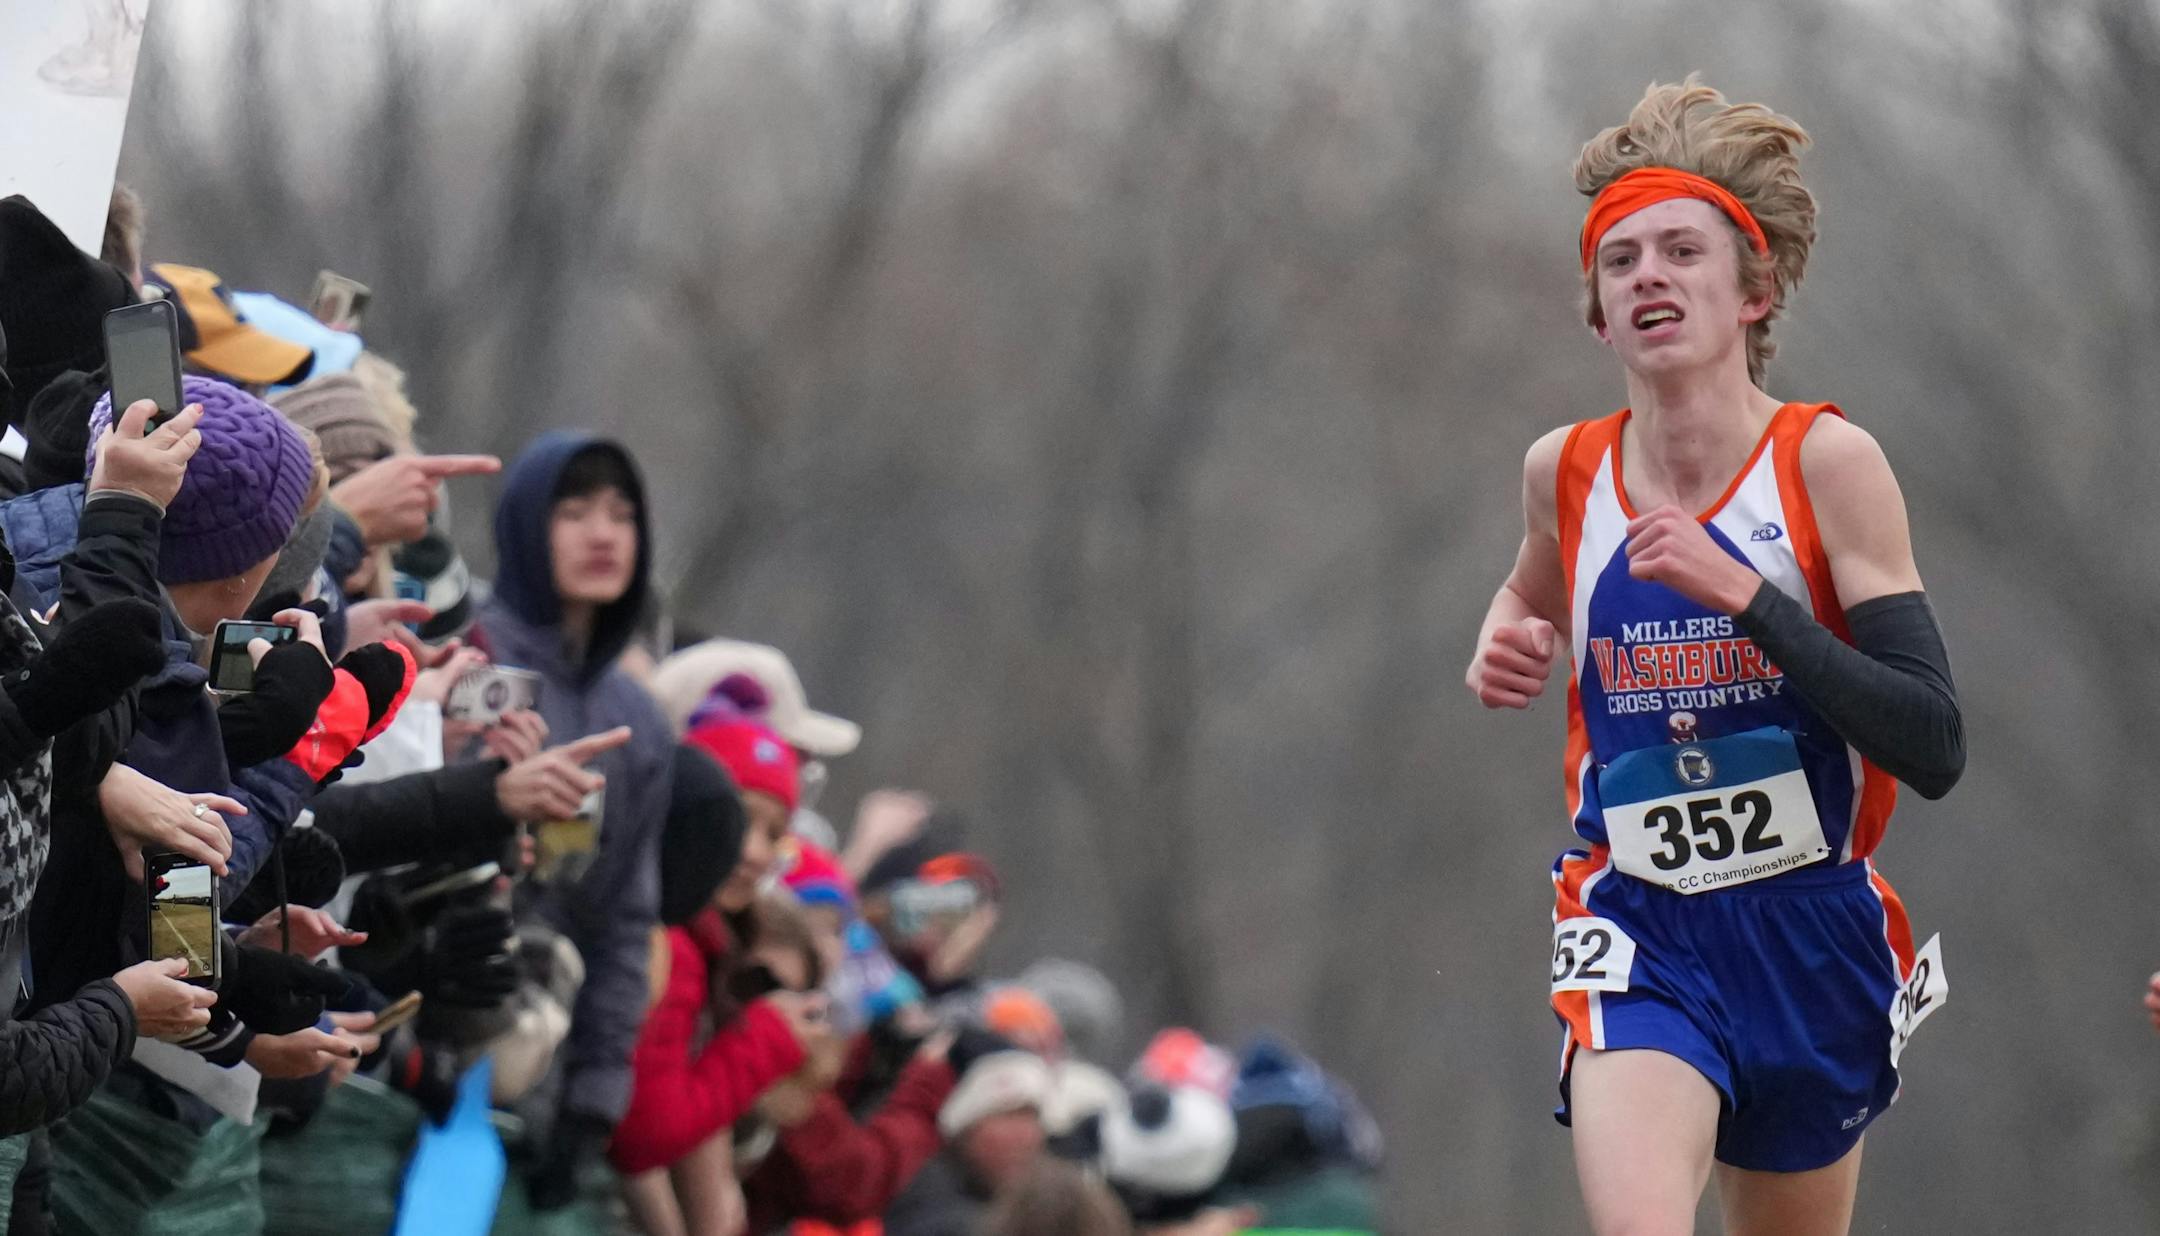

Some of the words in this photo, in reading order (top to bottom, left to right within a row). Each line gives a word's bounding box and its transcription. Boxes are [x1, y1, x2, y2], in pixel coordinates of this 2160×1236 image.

[1751, 526, 1775, 541] PCS
[1622, 616, 1733, 643] MILLERS
[1590, 637, 1783, 693] WASHBUR
[1608, 692, 1662, 714] CROSS
[1668, 681, 1783, 709] COUNTRY
[1644, 790, 1784, 871] 352
[1679, 876, 1699, 889] CC
[1703, 850, 1808, 884] Championships
[1552, 928, 1611, 983] 52
